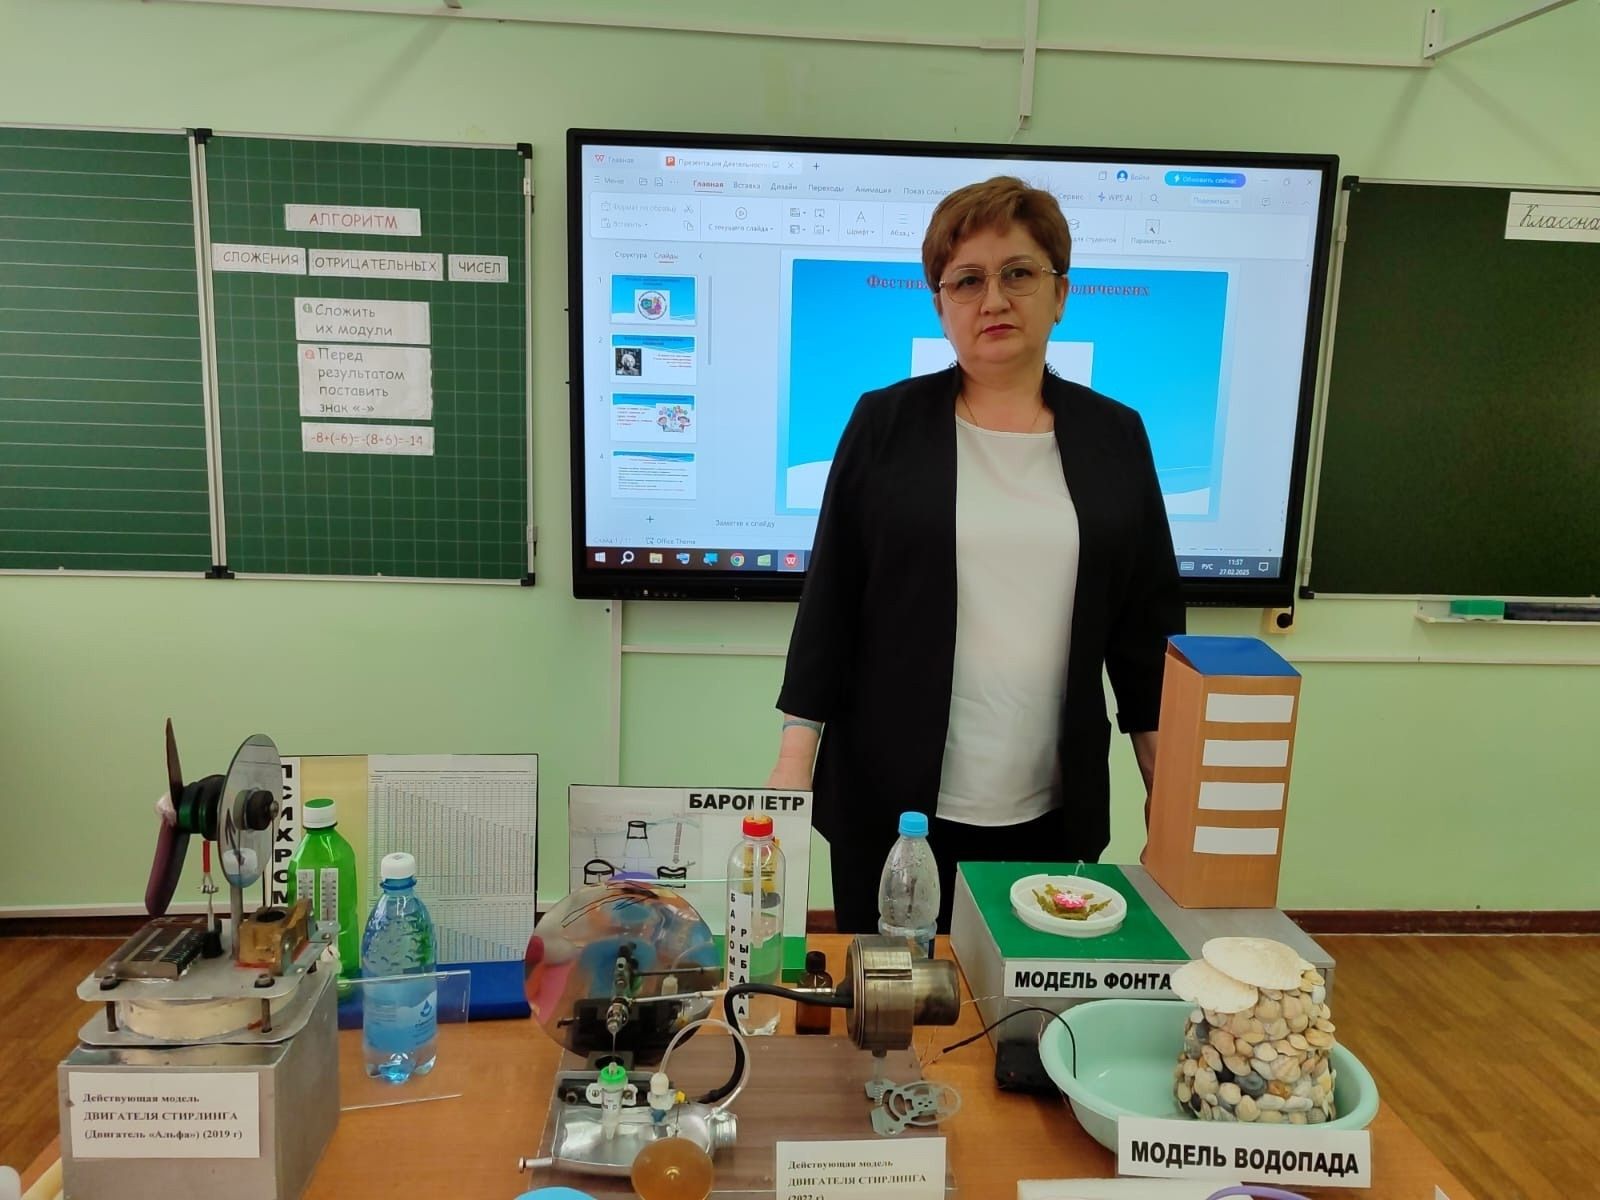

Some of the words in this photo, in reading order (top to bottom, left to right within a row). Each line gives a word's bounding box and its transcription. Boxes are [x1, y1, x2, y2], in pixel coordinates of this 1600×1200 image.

[693, 179, 724, 189] Главная
[733, 181, 761, 190] Вставка
[770, 182, 798, 191] Дизайн
[808, 184, 845, 193] Переходы
[855, 185, 892, 194] Анимация
[903, 187, 925, 195] Показ
[1058, 192, 1085, 202] Сервис
[1108, 194, 1124, 202] WPS
[308, 211, 399, 230] АЛГОРИТМ
[614, 250, 648, 260] Структура
[653, 252, 679, 260] Слайды
[222, 250, 300, 266] СЛОЖЕНИЯ
[314, 255, 437, 273] ОТРИЦАТЕЛЬНЫХ
[458, 261, 501, 275] ЧИСЕЛ
[867, 274, 929, 289] Фестив
[315, 303, 376, 318] Сложить
[315, 324, 333, 334] их
[338, 325, 393, 339] модули
[318, 347, 364, 365] Перед
[318, 368, 405, 382] результатом
[319, 386, 389, 397] поставить
[319, 403, 348, 413] знак
[715, 519, 744, 528] Заметки
[750, 520, 776, 529] слайду
[1201, 563, 1214, 571] РУС
[1219, 568, 1250, 576] 27.02.2025
[1014, 970, 1098, 991] МОДЕЛЬ
[1103, 971, 1172, 991] ФОНТА
[83, 1093, 159, 1105] Действующая
[161, 1095, 200, 1104] модель
[83, 1111, 159, 1122] ДВИГАТЕЛЯ
[161, 1111, 238, 1122] СТИРЛИНГА
[84, 1129, 146, 1140] (Двигатель
[148, 1129, 200, 1141] «Альфа»)
[202, 1129, 231, 1140] (2019
[1131, 1140, 1227, 1169] МОДЕЛЬ
[1233, 1147, 1359, 1175] ВОДОПАДА
[787, 1160, 857, 1171] Действующая
[858, 1160, 894, 1169] модель
[787, 1176, 856, 1187] ДВИГАТЕЛЯ
[857, 1174, 927, 1186] СТИРЛИНГА
